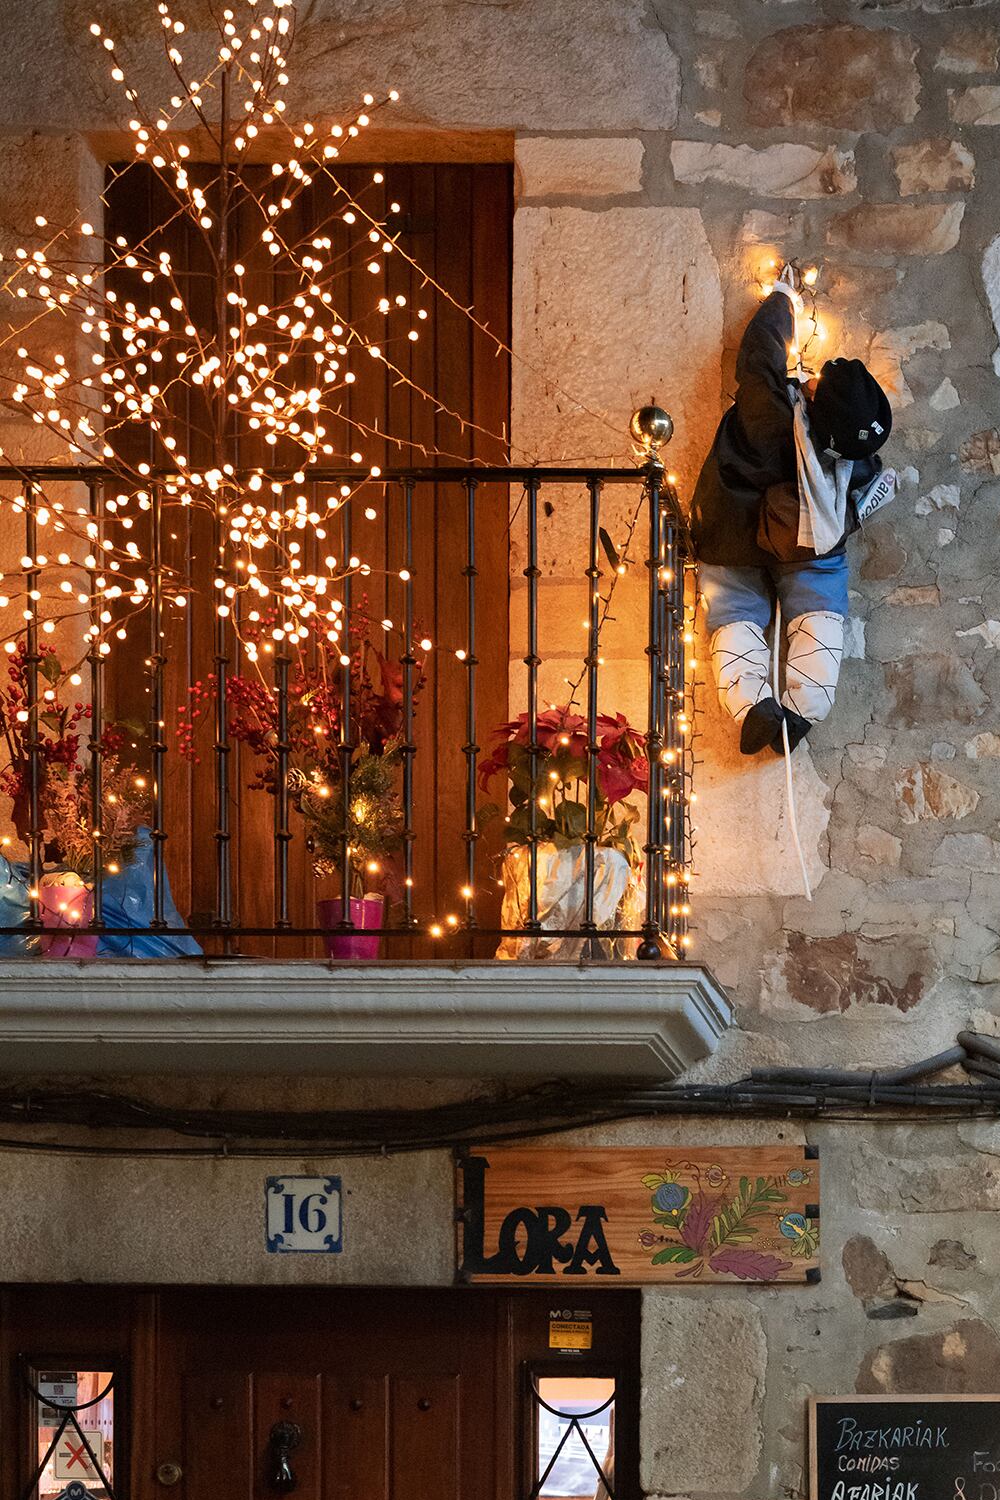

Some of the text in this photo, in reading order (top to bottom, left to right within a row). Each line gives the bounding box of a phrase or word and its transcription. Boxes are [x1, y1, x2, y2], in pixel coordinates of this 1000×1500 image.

[282, 1193, 328, 1234] 16
[457, 1156, 621, 1276] LORA
[834, 1417, 950, 1452] BAZKARIAK
[838, 1454, 901, 1473] COMIDAS
